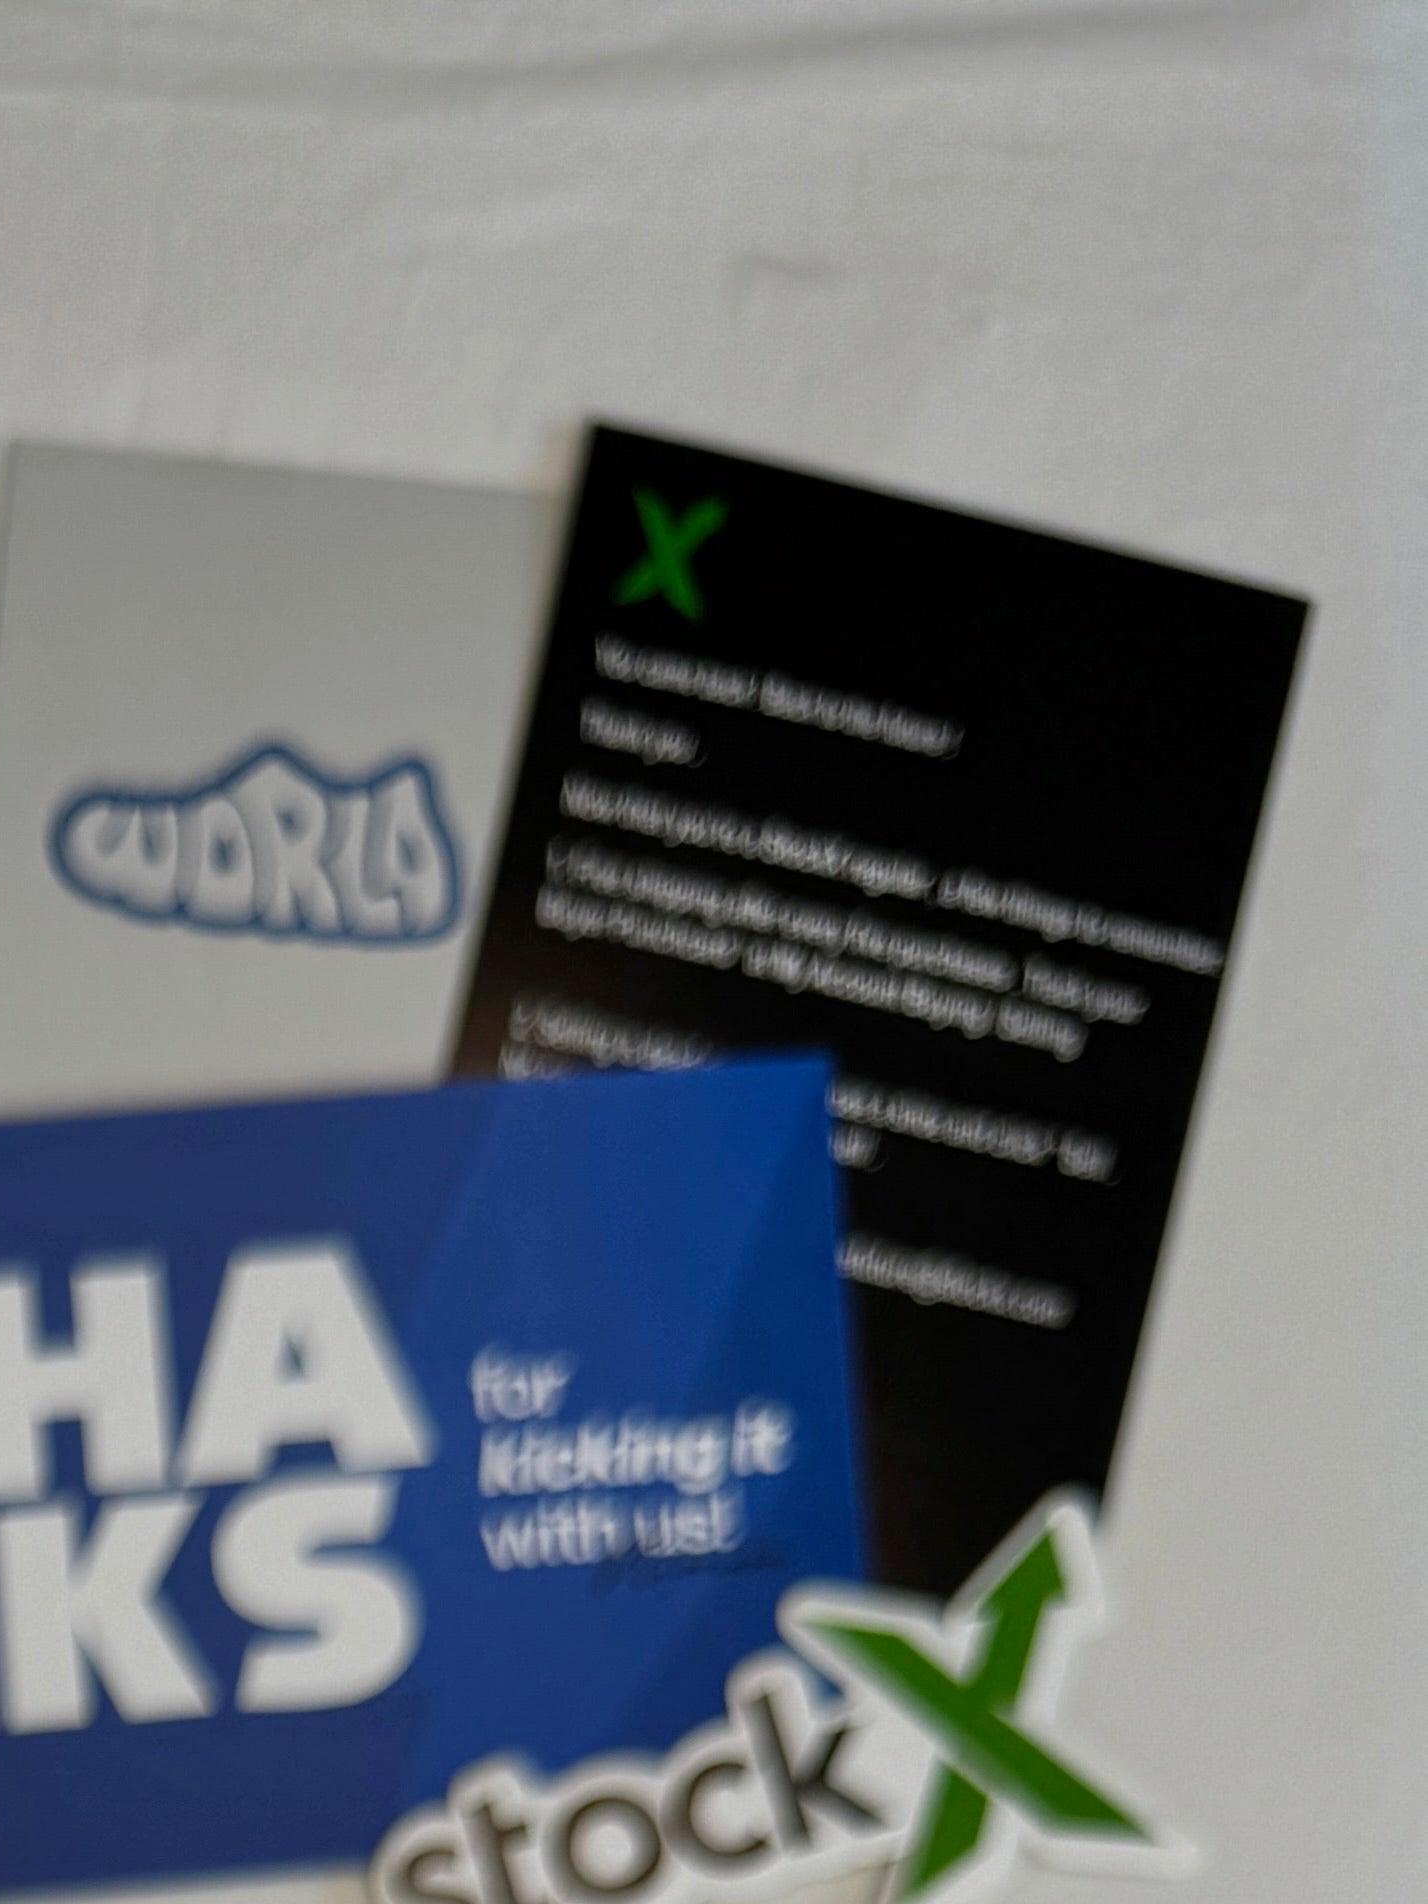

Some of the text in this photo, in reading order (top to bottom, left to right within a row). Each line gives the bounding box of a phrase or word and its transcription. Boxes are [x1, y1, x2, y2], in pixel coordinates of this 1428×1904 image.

[470, 1345, 570, 1423] for
[478, 1400, 794, 1498] kicking it
[481, 1500, 628, 1571] with
